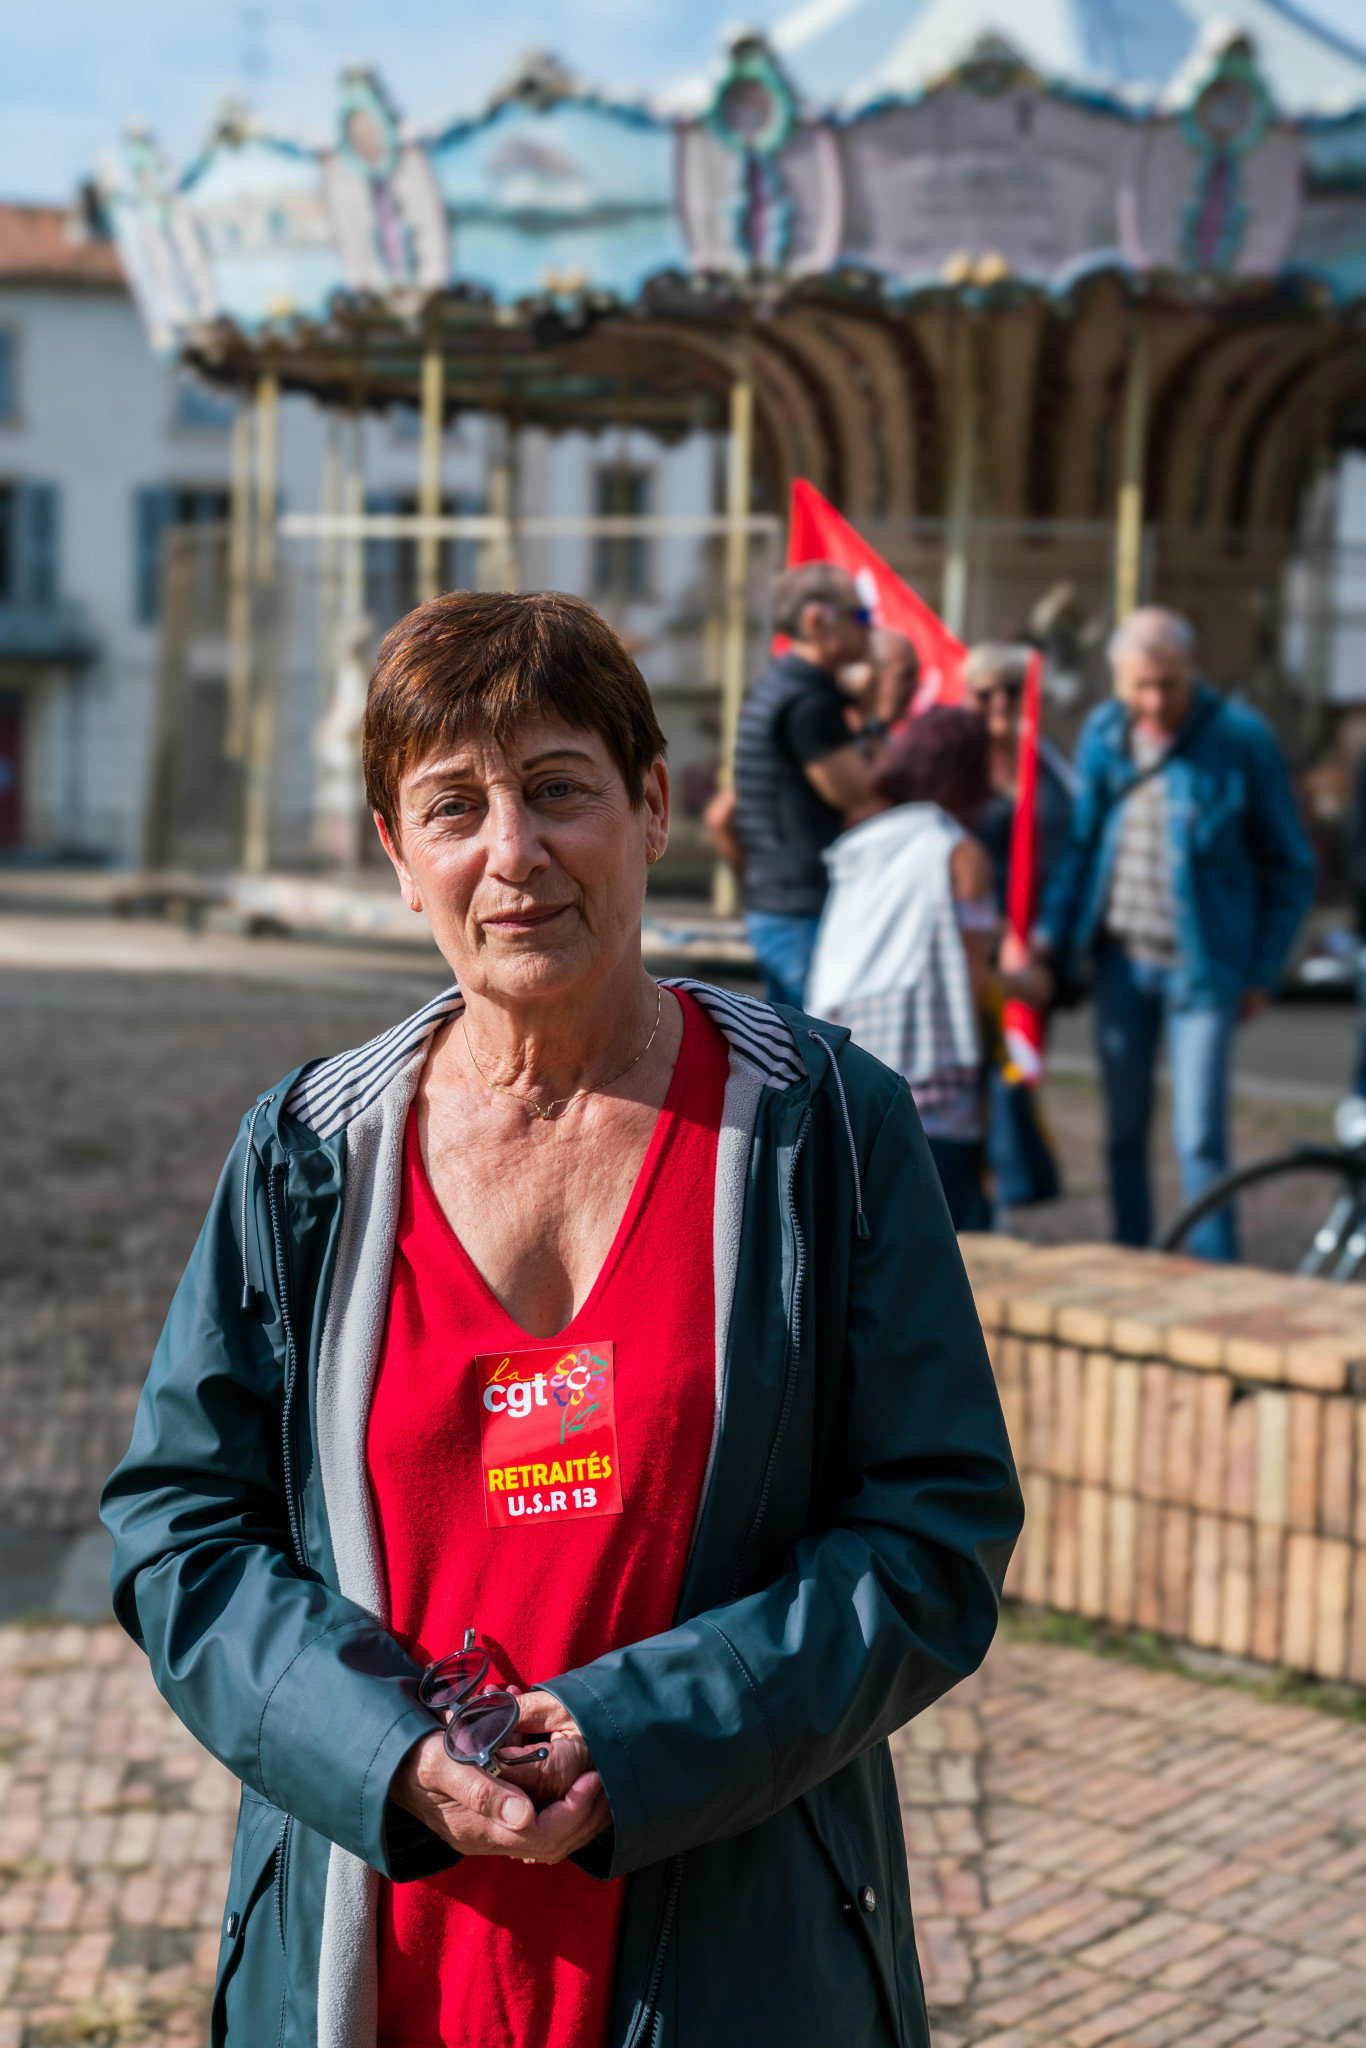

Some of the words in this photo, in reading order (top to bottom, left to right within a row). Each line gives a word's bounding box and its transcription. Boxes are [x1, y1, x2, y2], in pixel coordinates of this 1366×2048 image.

[486, 1357, 547, 1385] la
[483, 1372, 548, 1418] cgt
[488, 1451, 612, 1492] RETRAITÉS
[507, 1490, 567, 1517] U.S.R
[572, 1487, 598, 1509] 13
